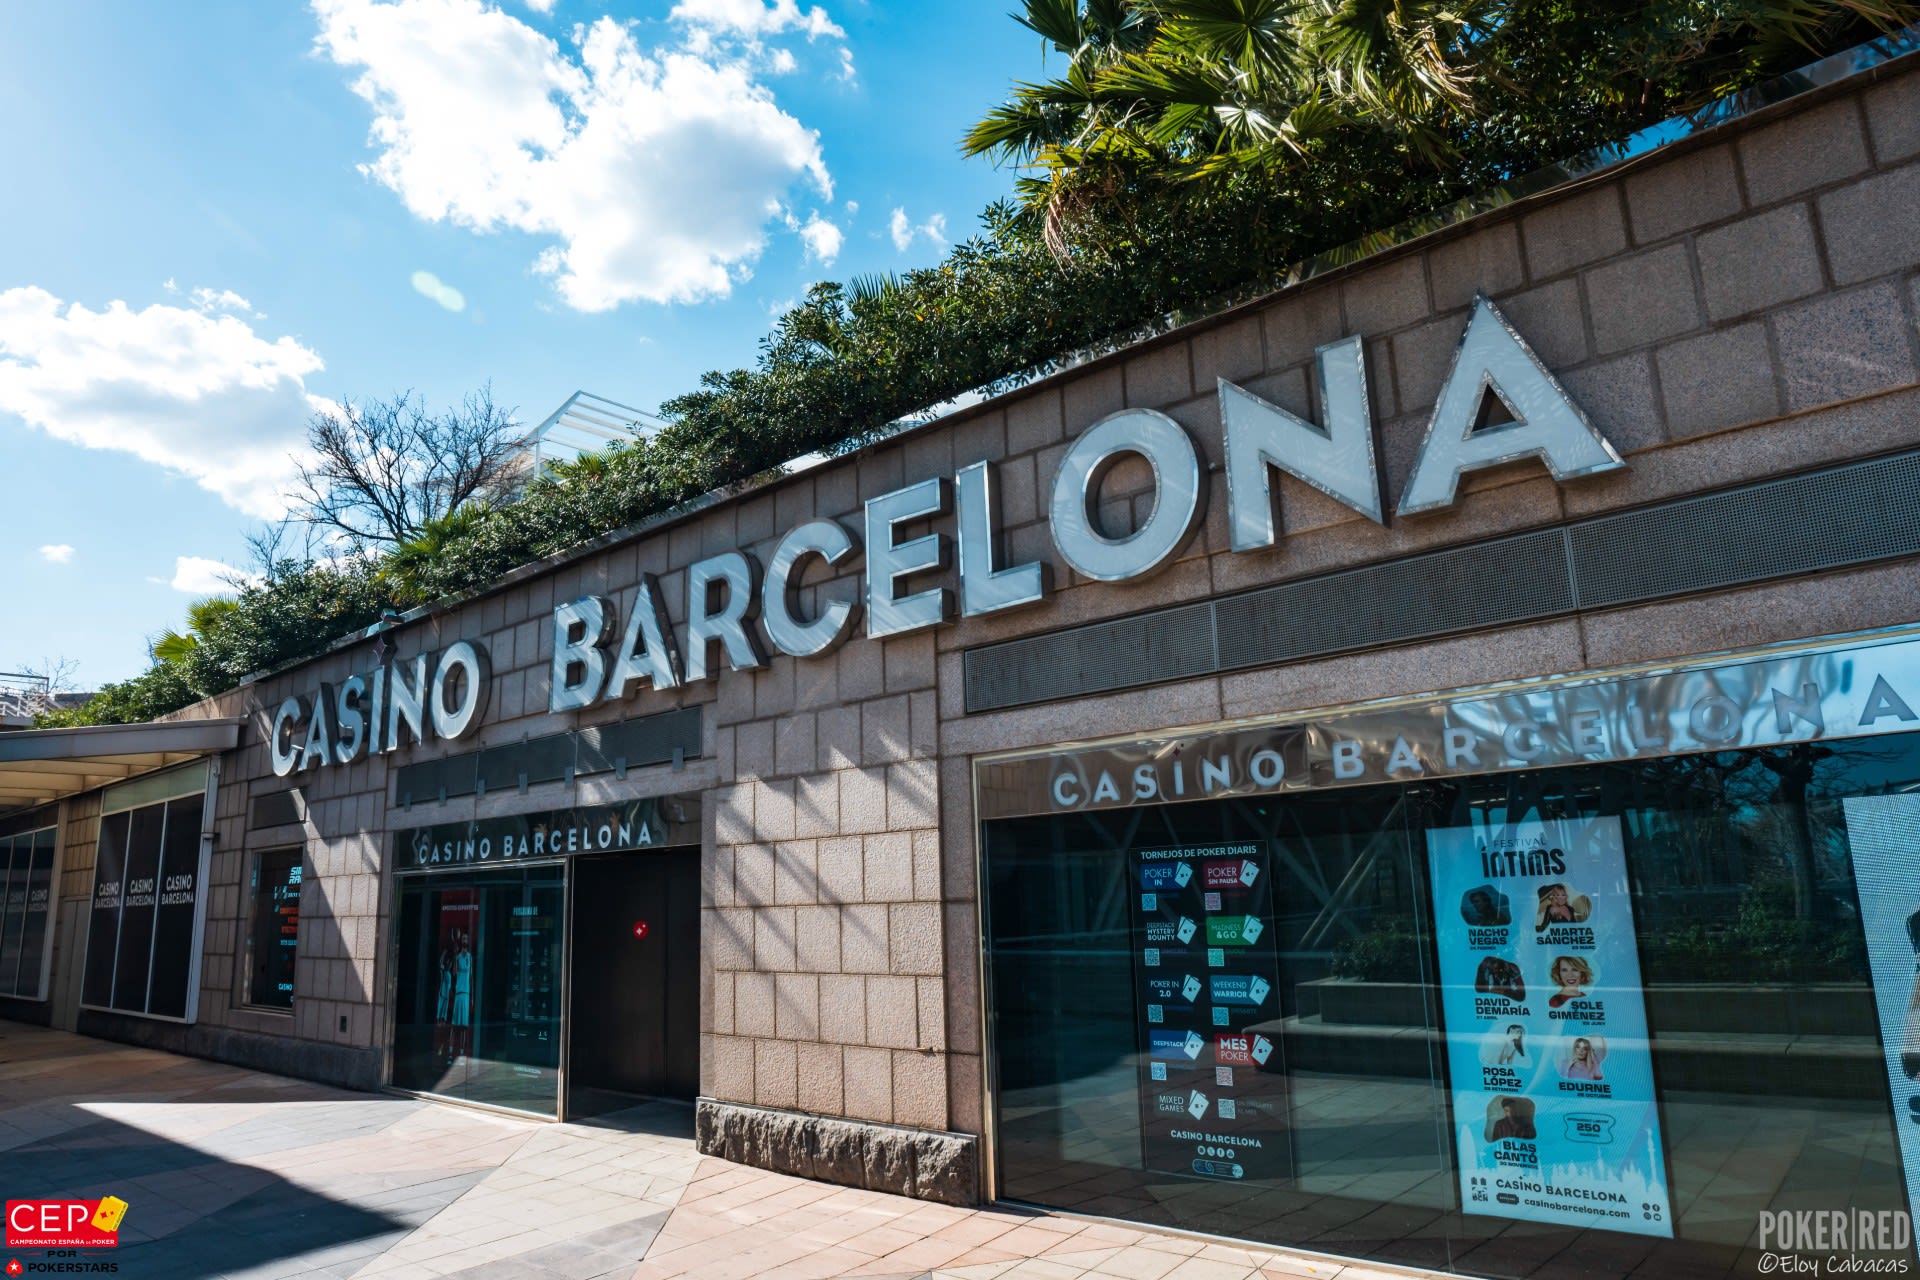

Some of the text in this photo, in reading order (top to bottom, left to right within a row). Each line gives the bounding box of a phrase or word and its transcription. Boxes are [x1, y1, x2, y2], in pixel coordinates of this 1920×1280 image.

[271, 290, 1628, 777] CASINO BARCELONA
[1053, 674, 1919, 807] CASINO BARCELONA
[418, 821, 652, 864] CASINO BARCELONA
[1493, 836, 1547, 848] FESTIVAL
[1141, 845, 1257, 860] TORNEJOS DE POKER DIARIS
[1144, 868, 1173, 879] POKER
[1207, 867, 1238, 878] POKER
[98, 881, 120, 896] CASINO
[130, 878, 154, 894] CASINO
[165, 874, 193, 891] CASINO
[126, 893, 155, 907] BARCELONA
[161, 890, 194, 905] BARCELONA
[1468, 928, 1509, 937] NACHO
[1549, 927, 1594, 937] MARTA
[1469, 937, 1508, 945] VEGAS
[1536, 934, 1596, 945] SÁNCHEZ
[1150, 980, 1180, 989] POKER IN
[1213, 981, 1248, 989] WEEKEND
[1159, 990, 1172, 998] 2.0
[1213, 990, 1248, 998] WARRIOR
[1474, 997, 1511, 1007] DAVID
[1570, 1001, 1604, 1010] SOLE
[1475, 1005, 1531, 1017] DEMARÍA
[1548, 1008, 1606, 1021] GIMÉNEZ
[1153, 1040, 1184, 1048] DEEPSTACK
[1220, 1038, 1248, 1051] MES
[1220, 1051, 1249, 1061] POKER
[1482, 1066, 1516, 1077] ROSA
[1483, 1076, 1523, 1088] LÓPEZ
[1559, 1081, 1612, 1094] EDURNE
[1159, 1095, 1184, 1105] MIXED
[1159, 1103, 1185, 1113] GAMES
[1576, 1122, 1601, 1133] 250
[1170, 1129, 1262, 1149] CASINO BARCELONA
[1502, 1140, 1537, 1153] BLAS
[1493, 1150, 1538, 1164] CANTÓ
[1496, 1178, 1628, 1204] CASINO BARCELONA
[1524, 1198, 1631, 1219] casinobarcelona.com
